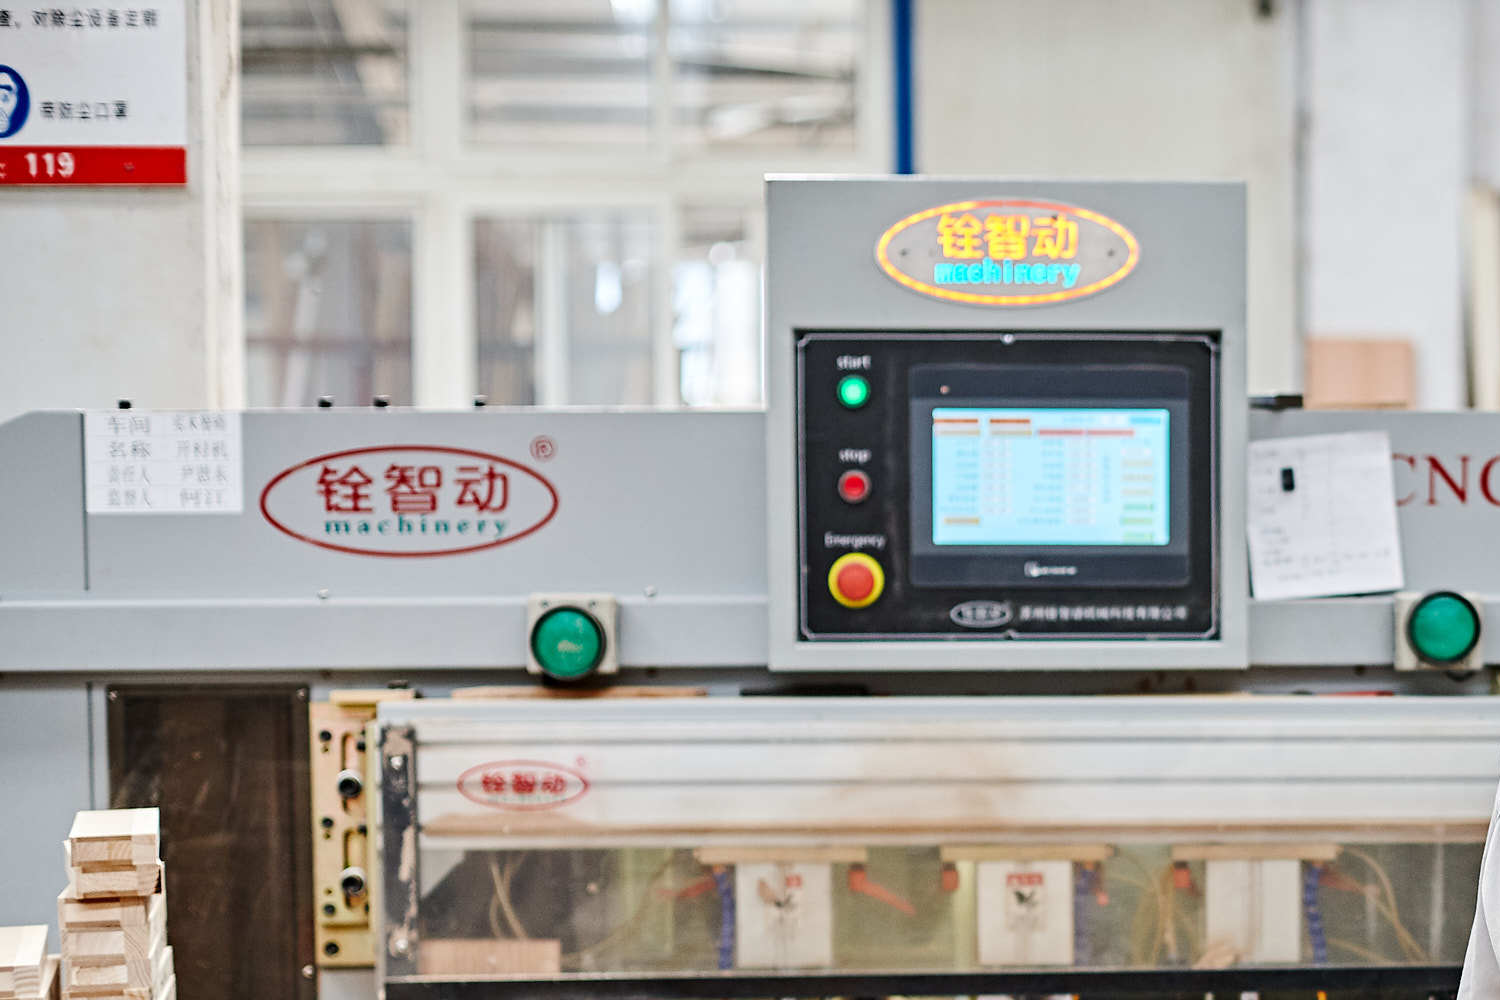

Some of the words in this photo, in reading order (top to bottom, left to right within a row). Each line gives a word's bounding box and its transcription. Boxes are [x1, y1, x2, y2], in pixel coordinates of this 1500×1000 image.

[24, 151, 76, 178] 119
[937, 213, 1080, 260] 铨智动
[934, 258, 1081, 288] machinery
[316, 463, 510, 514] 铨智动
[324, 513, 508, 540] machinery
